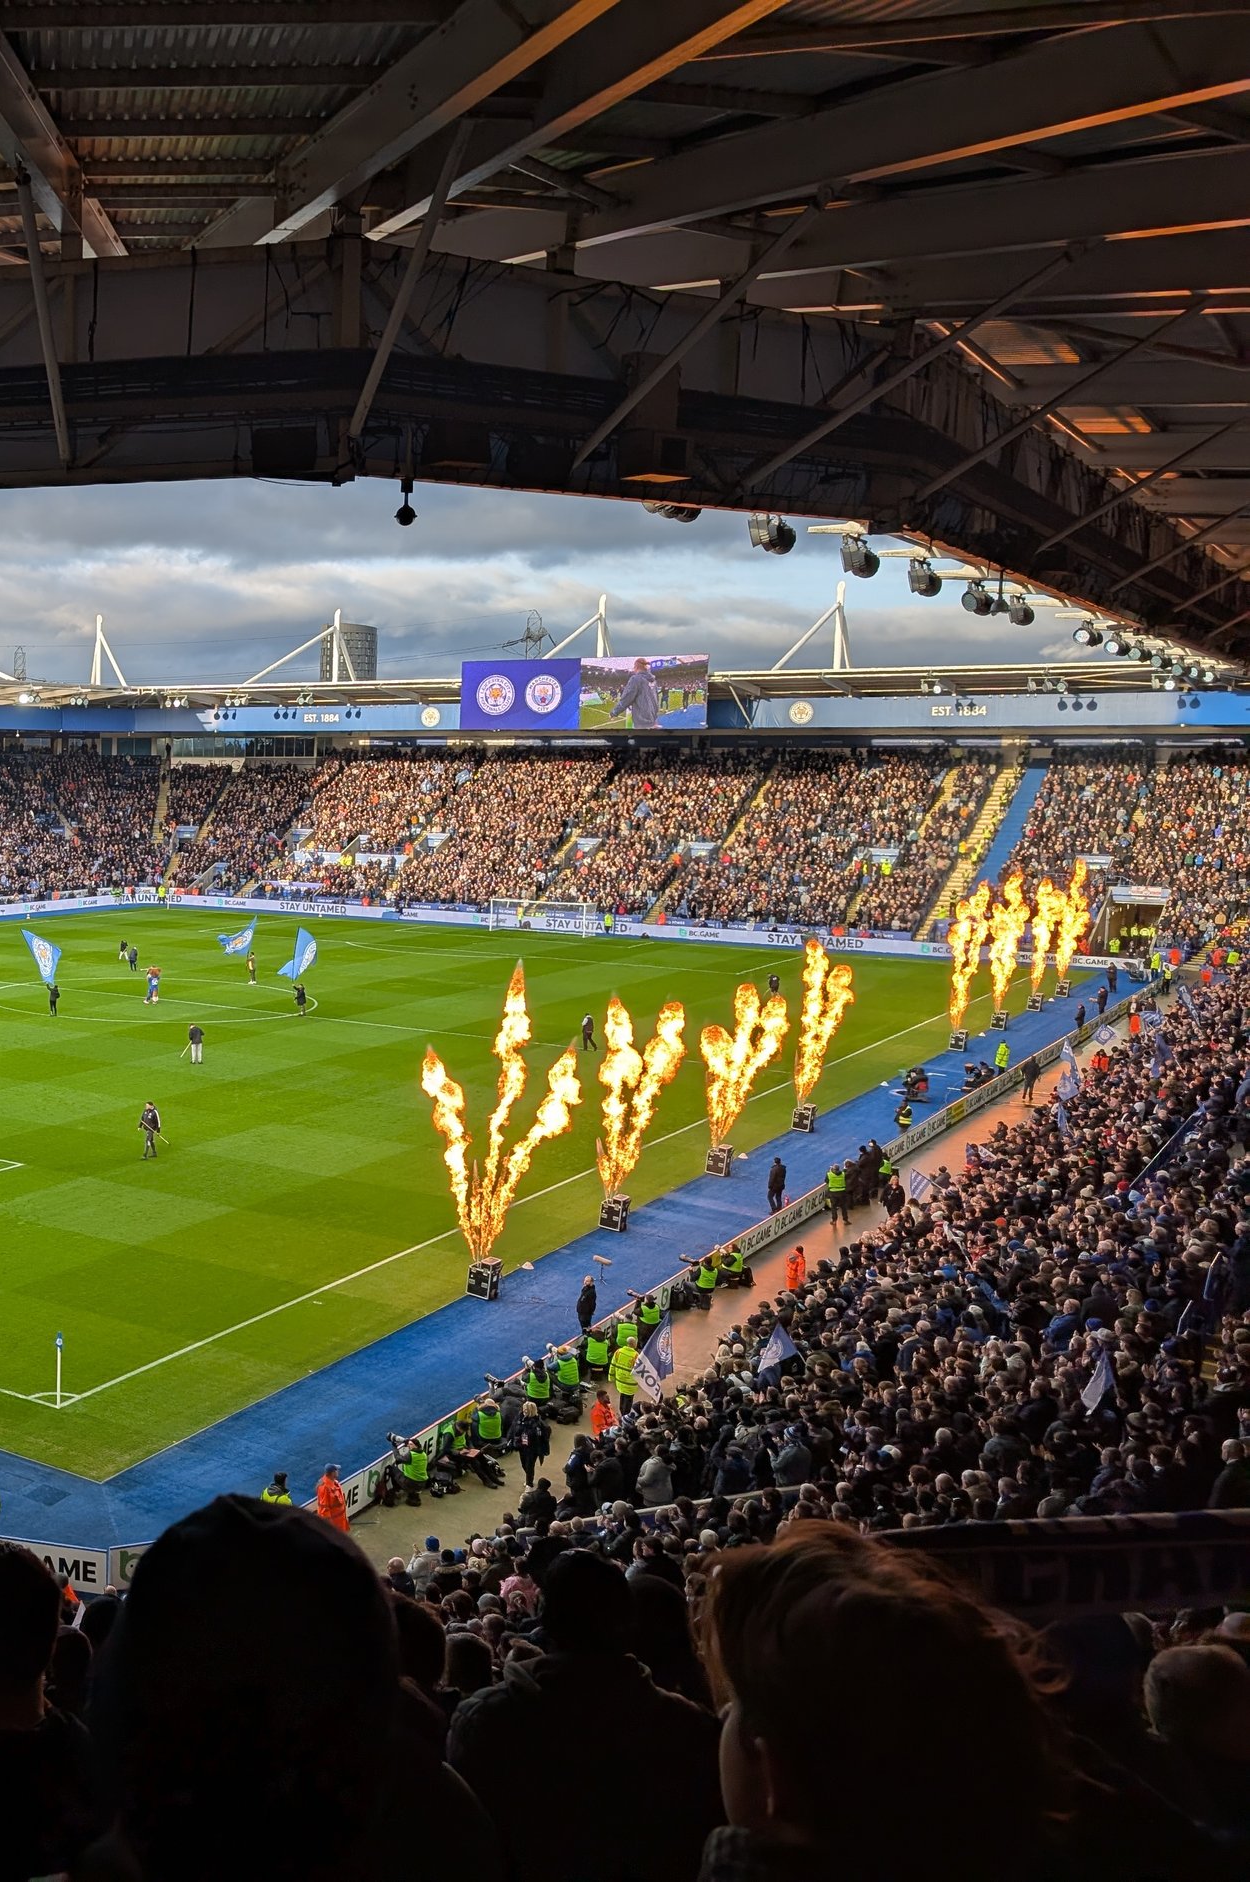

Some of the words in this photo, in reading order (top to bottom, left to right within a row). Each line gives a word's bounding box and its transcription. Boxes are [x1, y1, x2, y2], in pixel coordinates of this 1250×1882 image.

[931, 706, 954, 716] EST.
[958, 706, 987, 716] 1884
[304, 714, 318, 722] EST.
[320, 714, 340, 722] 1884
[122, 895, 137, 903] TAY
[138, 894, 182, 902] UNTAED
[280, 902, 300, 911] STAY
[302, 902, 346, 914] UNTAMED
[546, 918, 570, 928] STAY
[574, 920, 628, 932] UNTAED
[688, 930, 720, 938] BC.GAME
[768, 934, 798, 944] STAY
[820, 936, 864, 949] TAMED
[1072, 958, 1108, 966] BC.GAME
